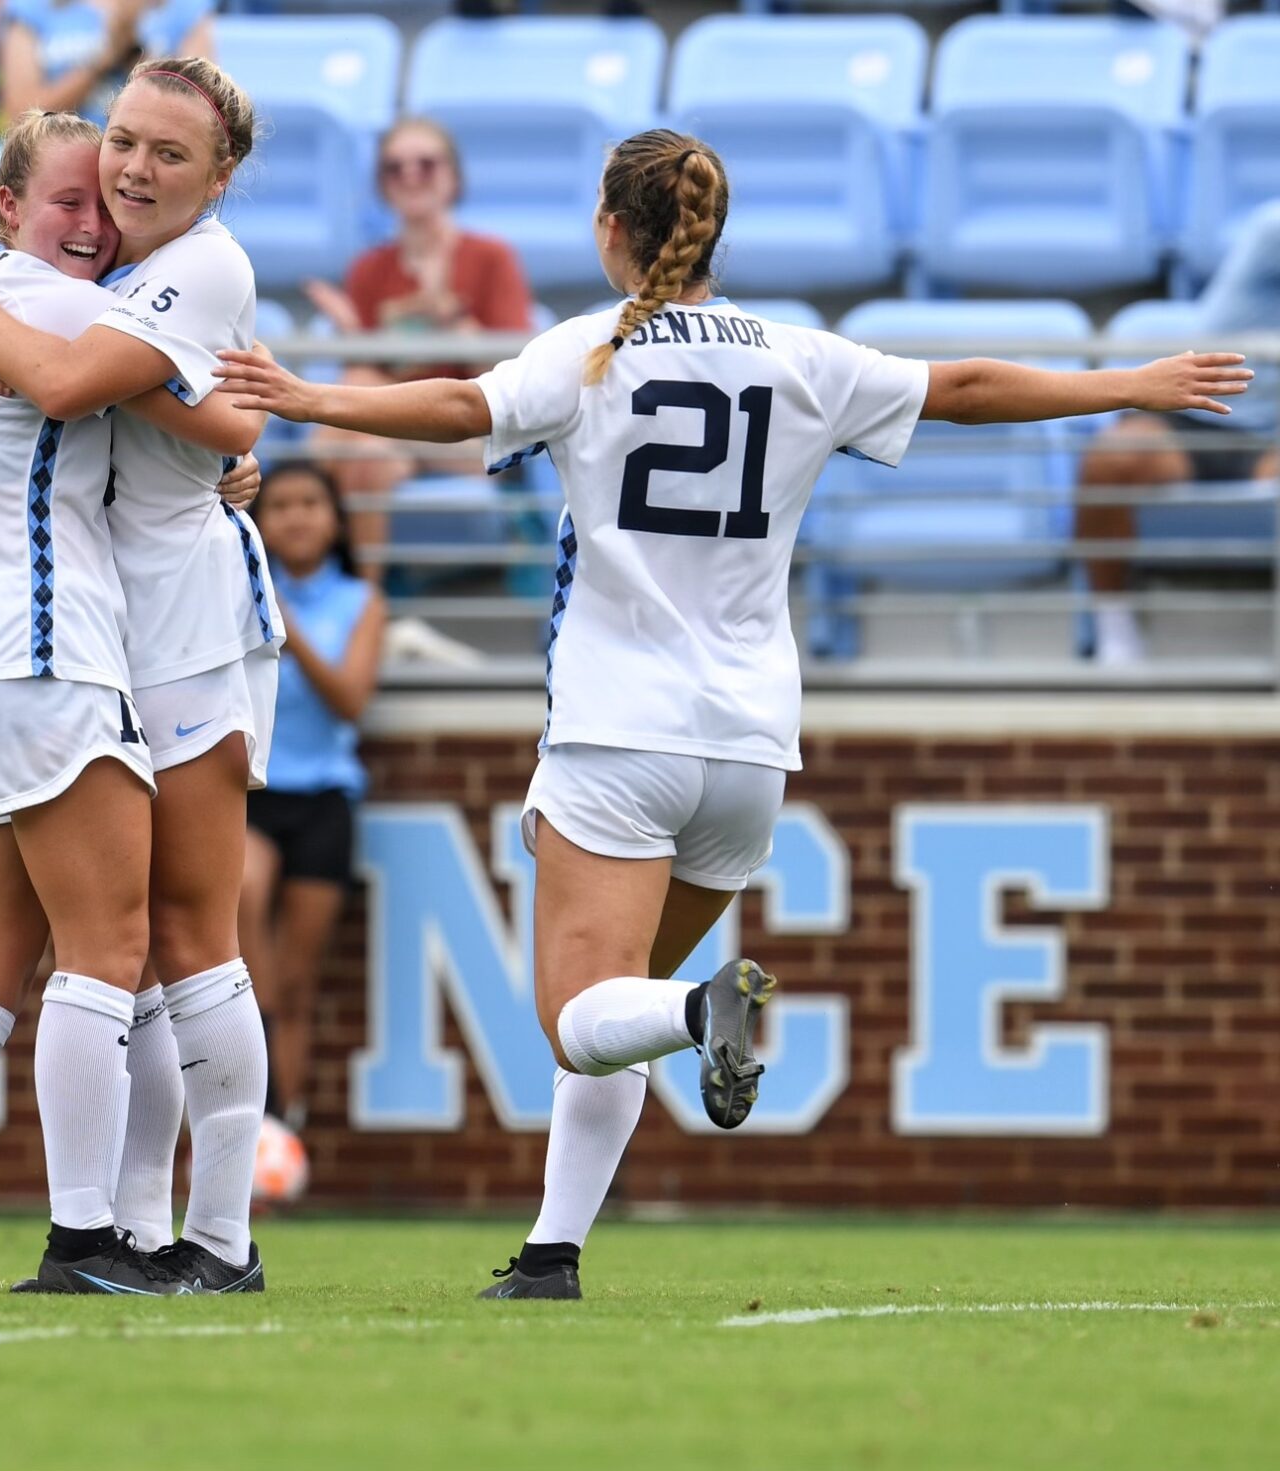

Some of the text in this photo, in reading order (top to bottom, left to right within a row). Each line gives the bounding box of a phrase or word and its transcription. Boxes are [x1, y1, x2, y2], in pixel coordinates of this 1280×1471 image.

[631, 311, 771, 349] SENTNOR
[618, 379, 773, 538] 21
[117, 690, 149, 746] 1
